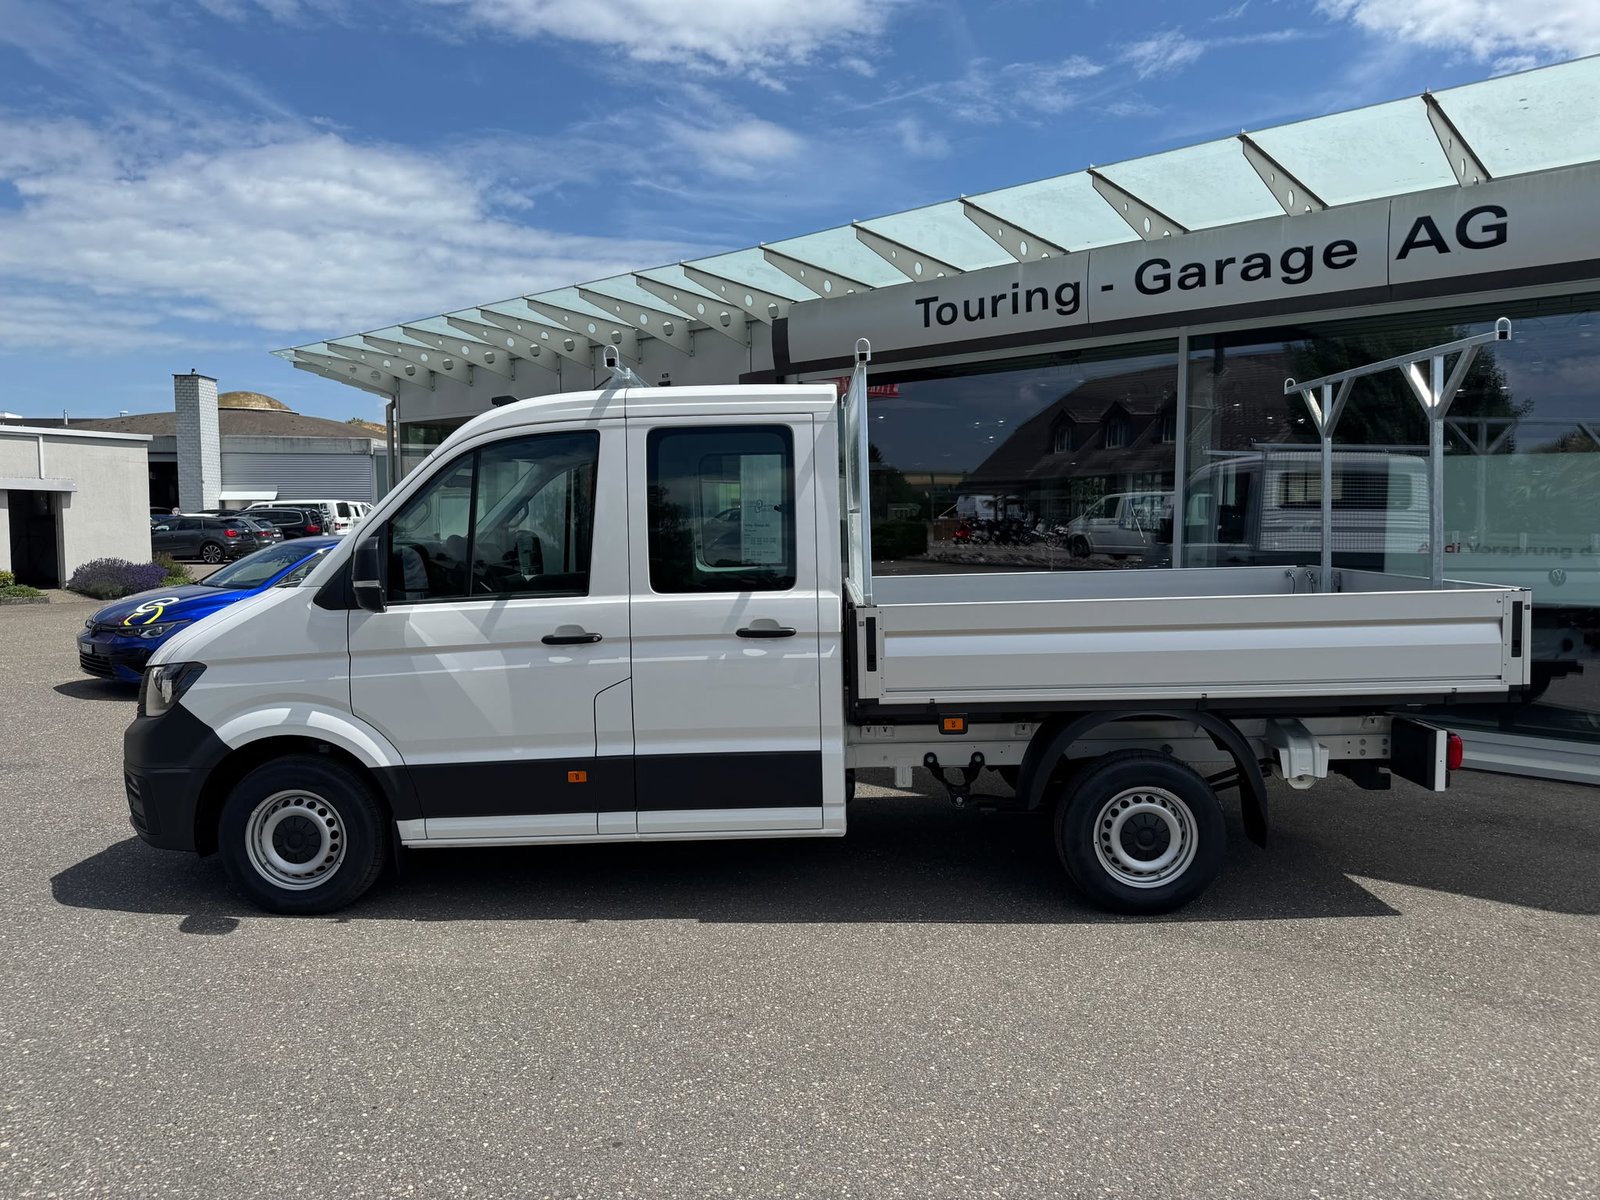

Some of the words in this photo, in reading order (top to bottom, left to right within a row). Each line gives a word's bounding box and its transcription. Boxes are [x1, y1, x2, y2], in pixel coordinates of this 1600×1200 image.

[915, 281, 1081, 329] Touring
[1134, 238, 1358, 297] Garage
[1395, 204, 1509, 261] AG
[1417, 542, 1461, 554] Adi
